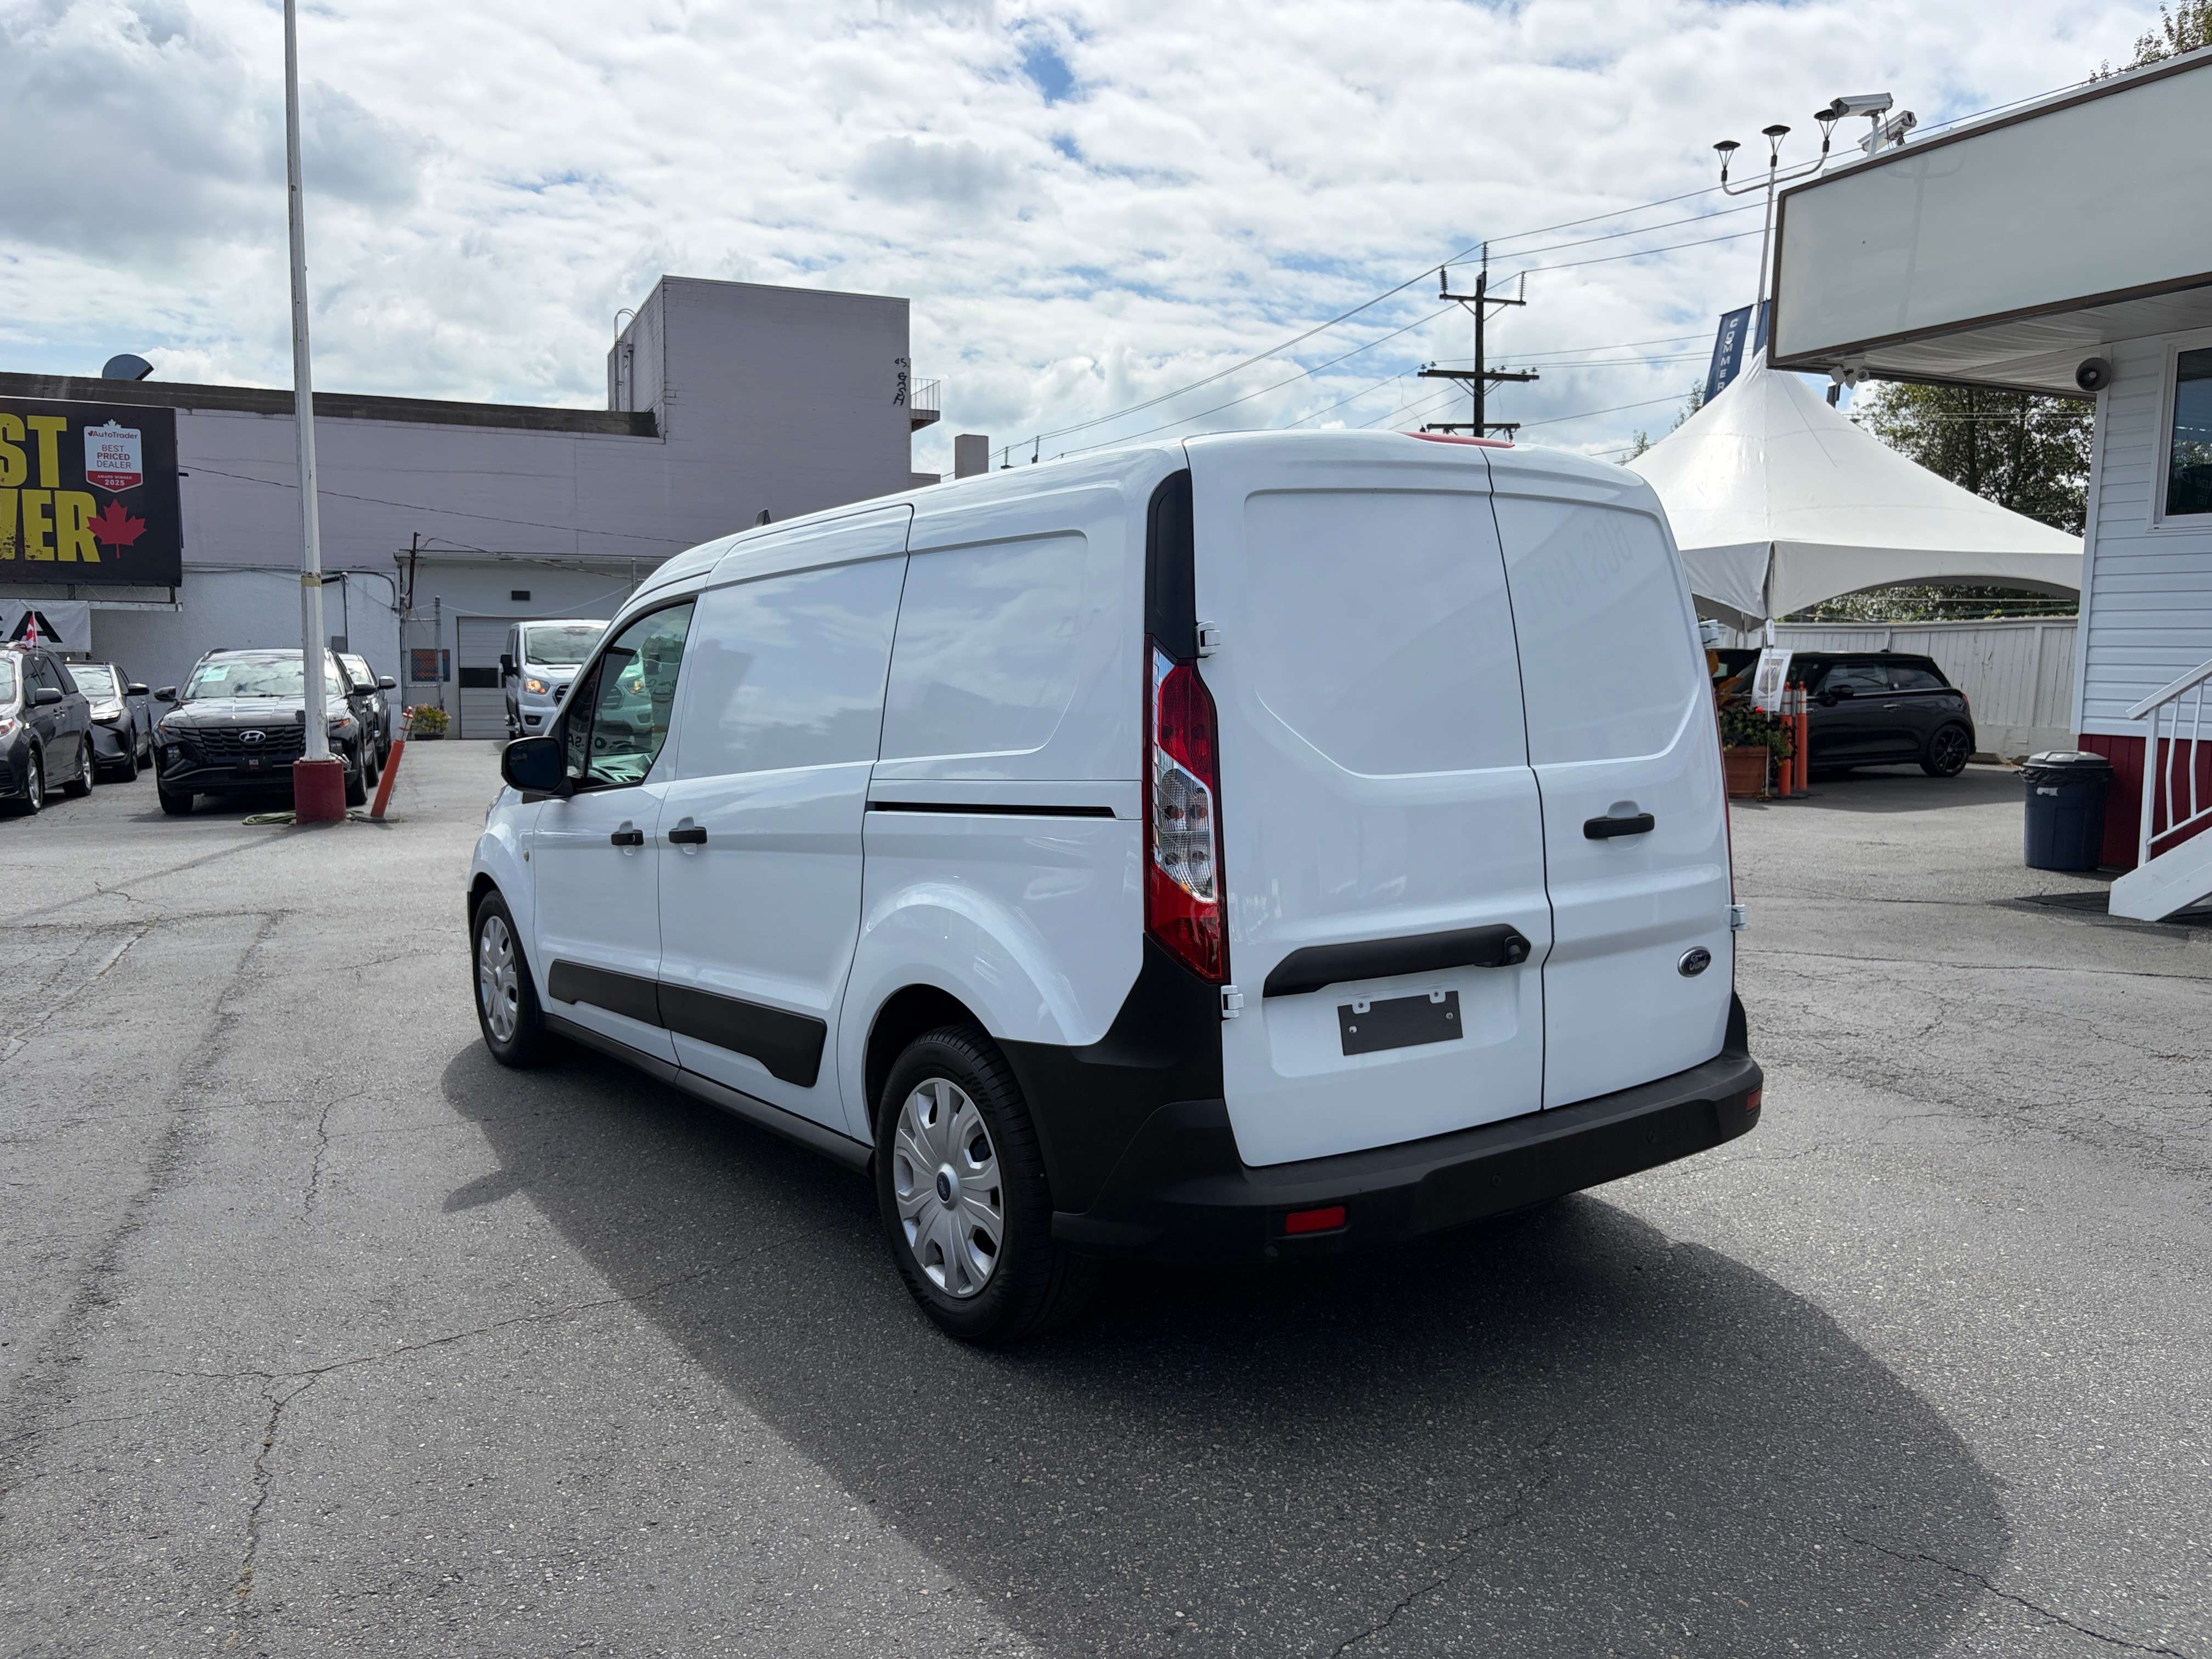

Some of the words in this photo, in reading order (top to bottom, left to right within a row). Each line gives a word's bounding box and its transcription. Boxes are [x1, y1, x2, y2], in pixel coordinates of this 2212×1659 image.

[93, 431, 138, 439] AutoTrader
[102, 444, 125, 453] BEST
[97, 452, 131, 461] PRICED
[97, 460, 132, 469] DEALER
[1689, 953, 1706, 971] Ford
